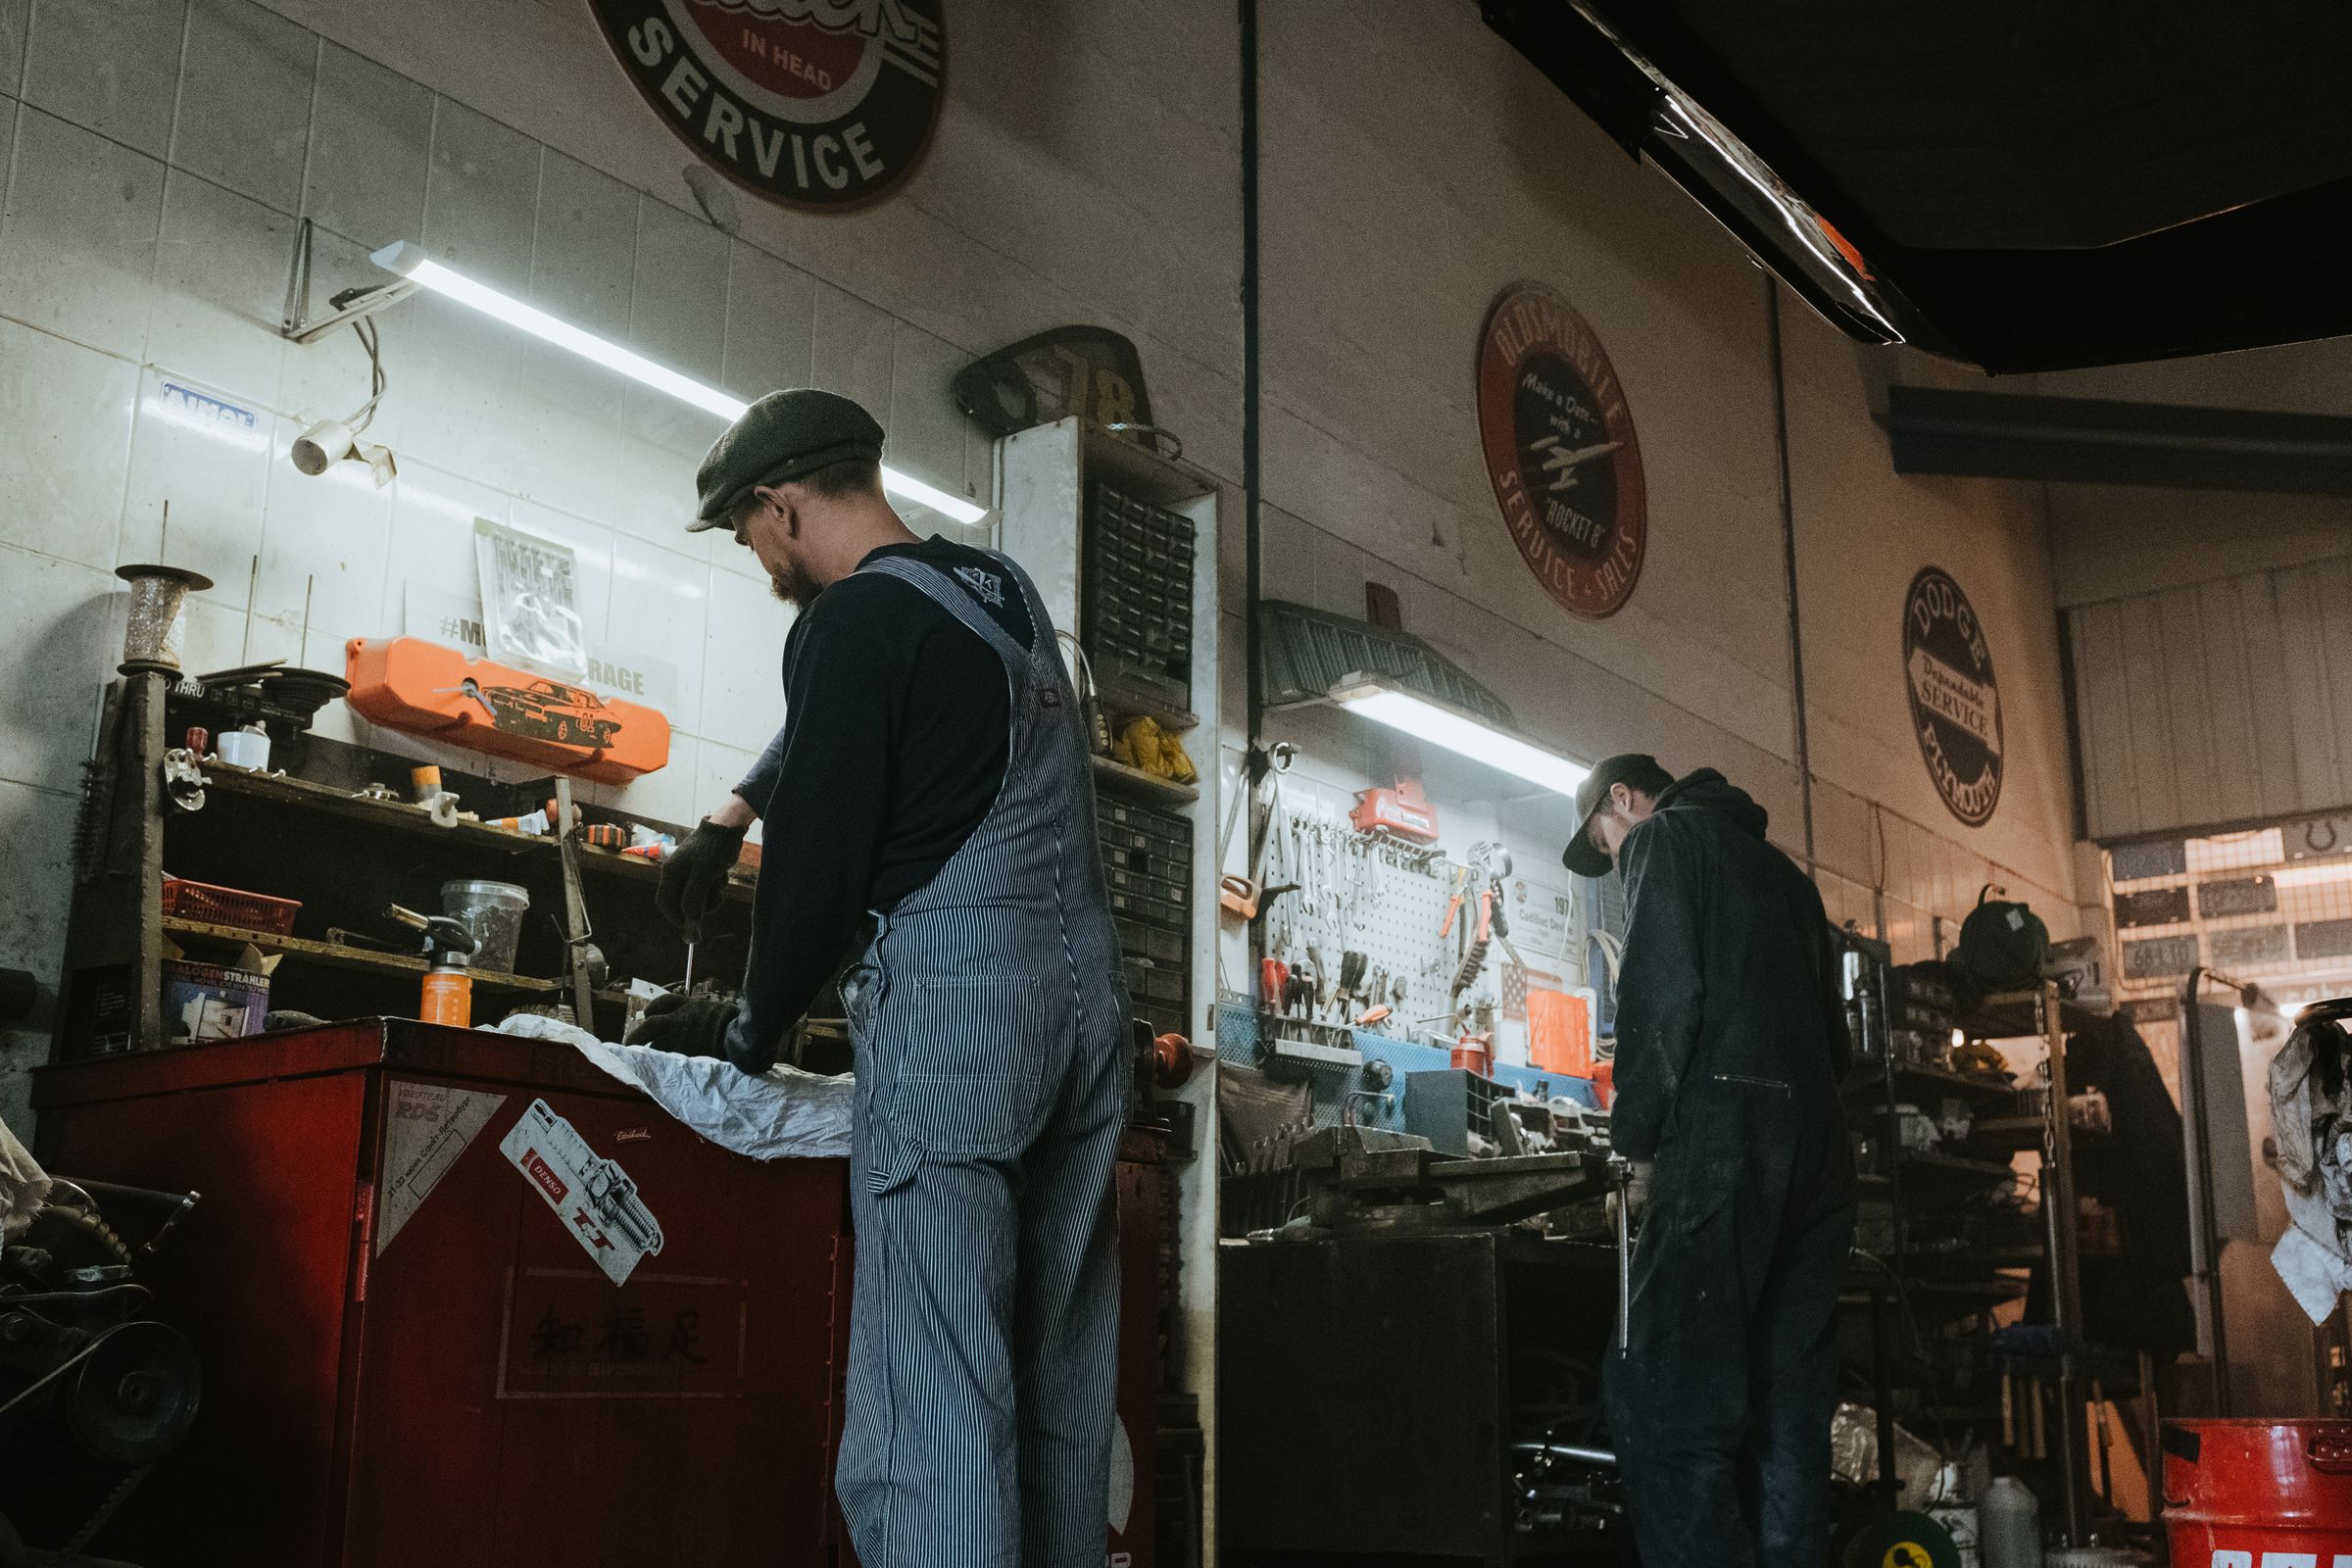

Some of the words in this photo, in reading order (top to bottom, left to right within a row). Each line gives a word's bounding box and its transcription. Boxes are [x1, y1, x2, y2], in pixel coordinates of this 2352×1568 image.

[742, 28, 766, 57] IN
[773, 46, 832, 91] HEAD
[628, 17, 885, 190] SERVICE
[1495, 301, 1623, 427] OLDSMOBILE
[1522, 373, 1555, 401] Make
[1549, 415, 1571, 436] with
[1572, 428, 1582, 440] a
[1595, 526, 1638, 600] SALES
[1914, 583, 1986, 671] DODGE
[174, 679, 206, 699] THRU
[1921, 680, 1987, 737] SERVICE
[579, 712, 596, 734] 01
[1923, 720, 1996, 814] PLYMOUTH
[1519, 908, 1548, 928] Cadillac
[395, 1101, 440, 1122] RDS
[534, 1164, 562, 1196] DENSO
